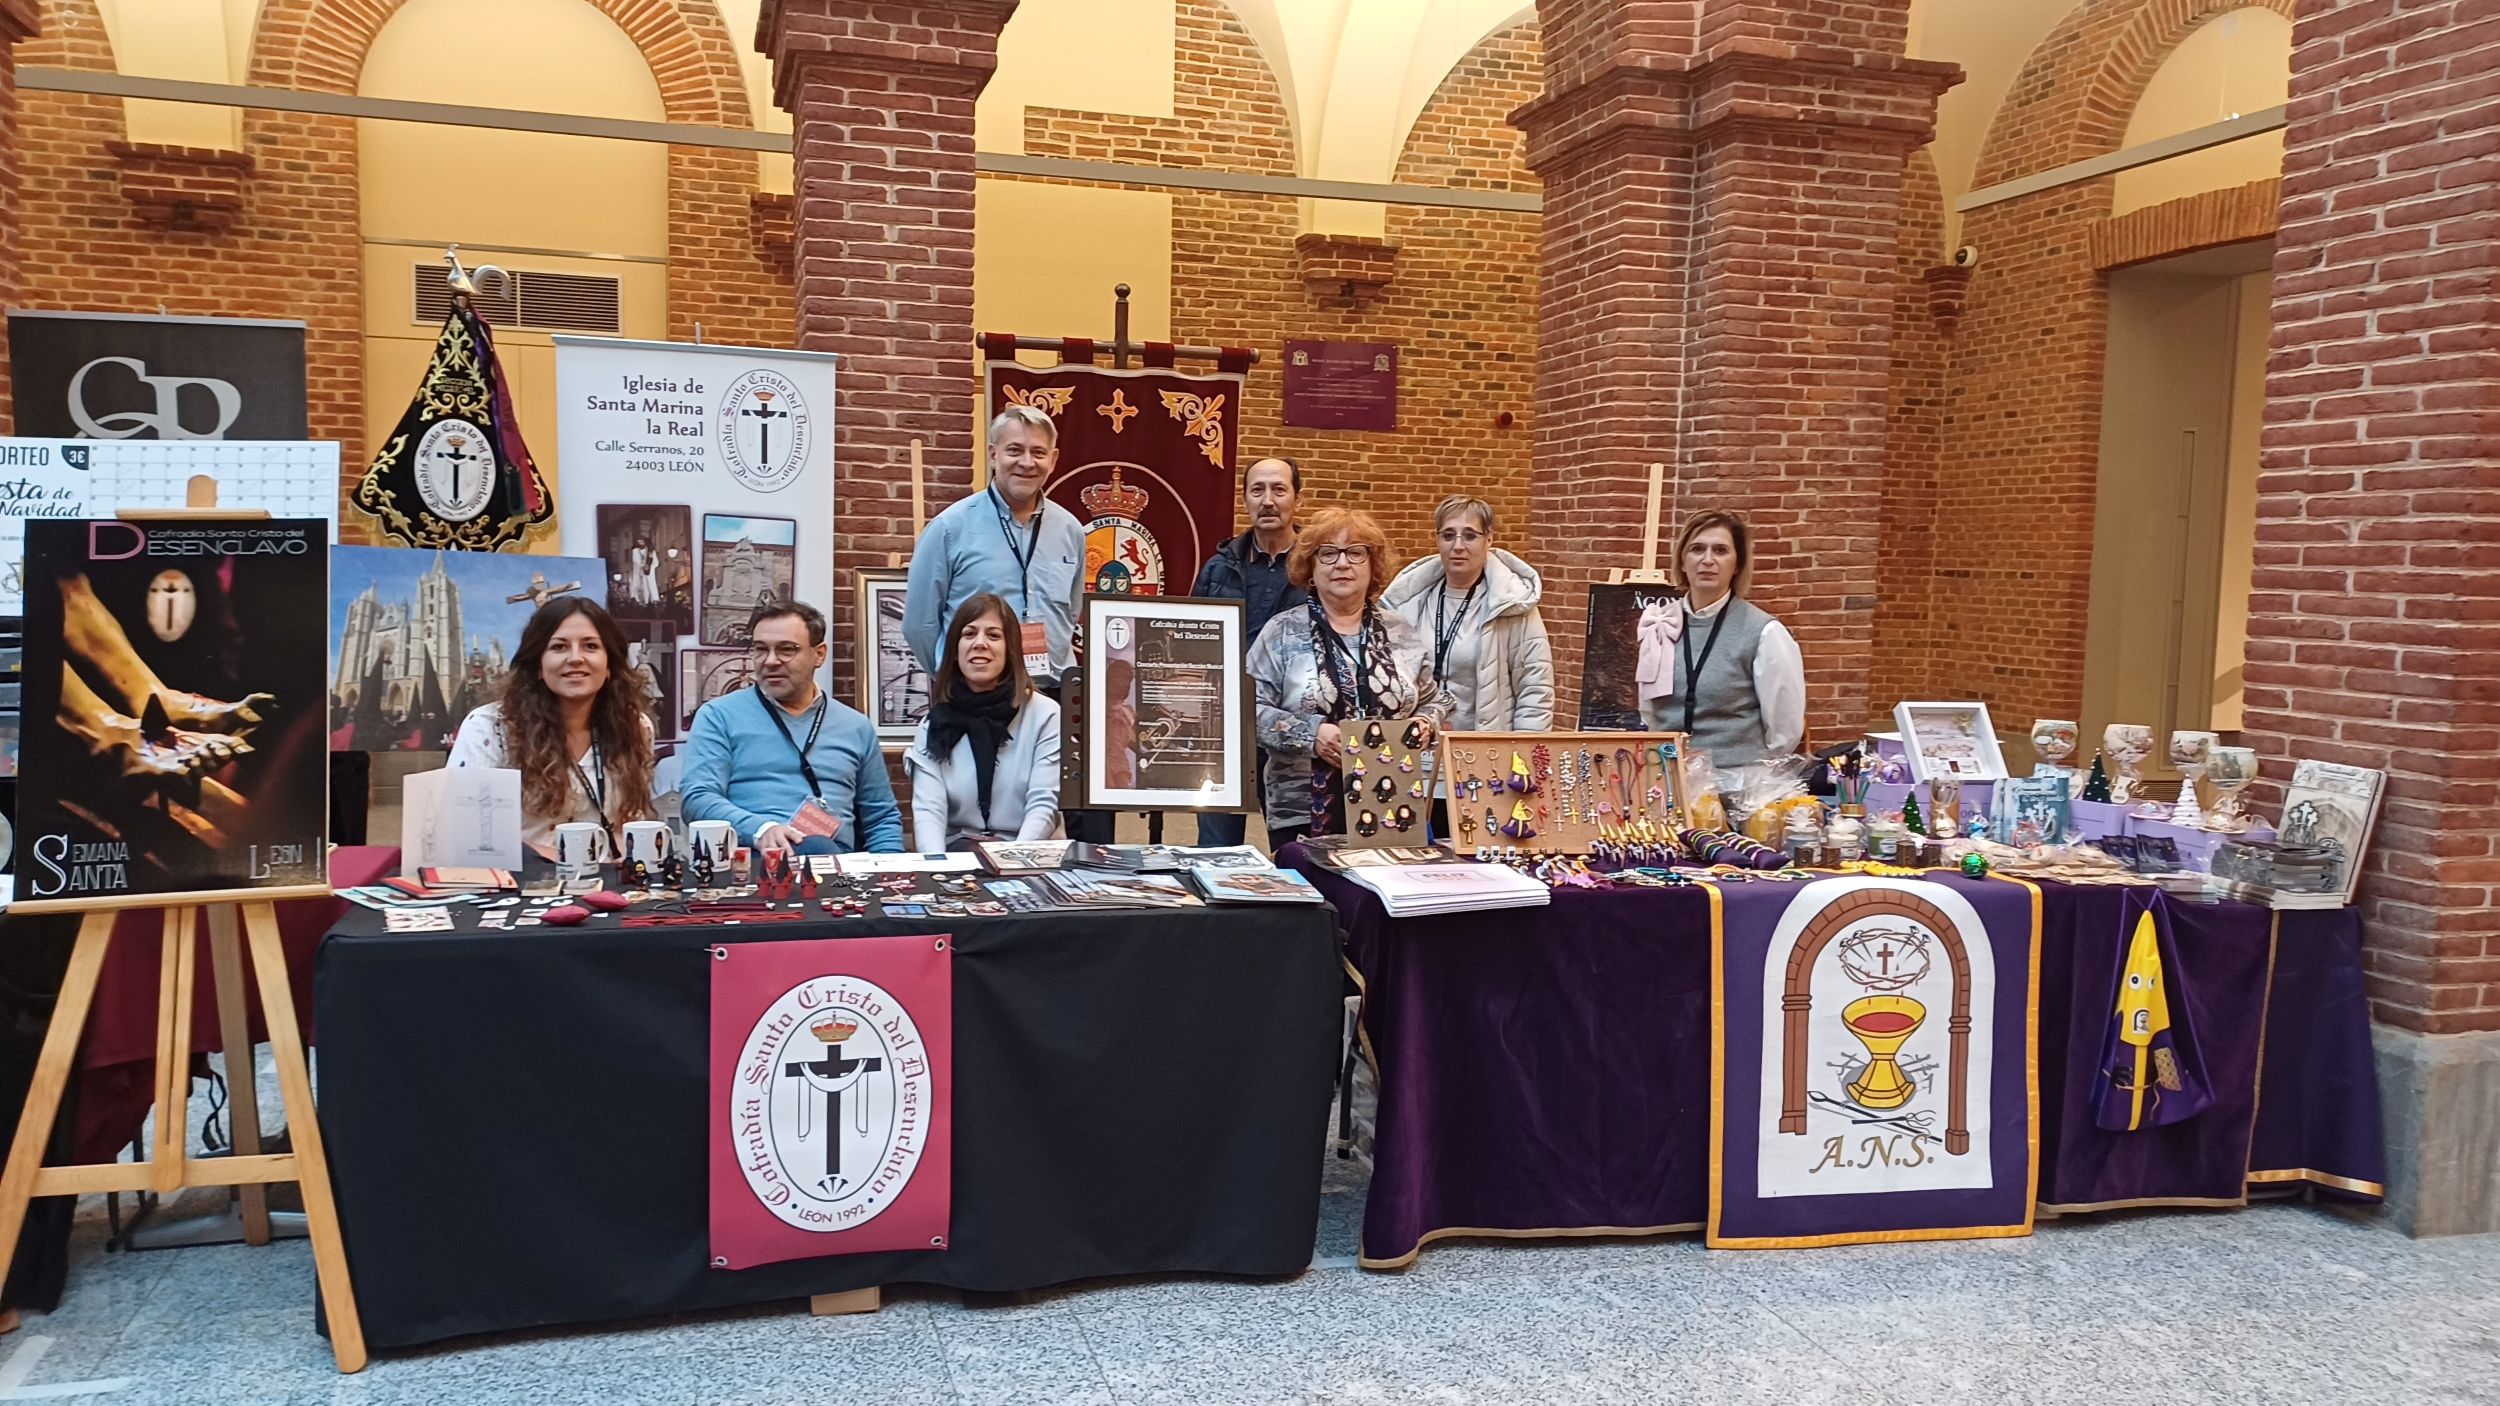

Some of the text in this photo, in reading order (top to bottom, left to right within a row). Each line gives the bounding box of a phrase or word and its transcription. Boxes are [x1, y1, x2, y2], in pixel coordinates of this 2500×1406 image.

[622, 374, 704, 395] Iglesia de
[748, 373, 787, 391] Cristo
[787, 392, 803, 409] del
[587, 395, 704, 415] Santa Marina
[646, 418, 704, 437] la Real
[595, 440, 704, 456] Calle Serranos, 20
[625, 459, 704, 472] 24003 LEÓN
[53, 487, 73, 499] de
[0, 499, 82, 517] Navidad
[1093, 518, 1121, 529] SANTA
[1131, 521, 1156, 548] MARINA
[740, 984, 926, 1206] Cofradía Santo Cristo del Desenclavo
[1808, 1134, 1934, 1174] A.N.S.
[837, 1204, 866, 1221] 1992
